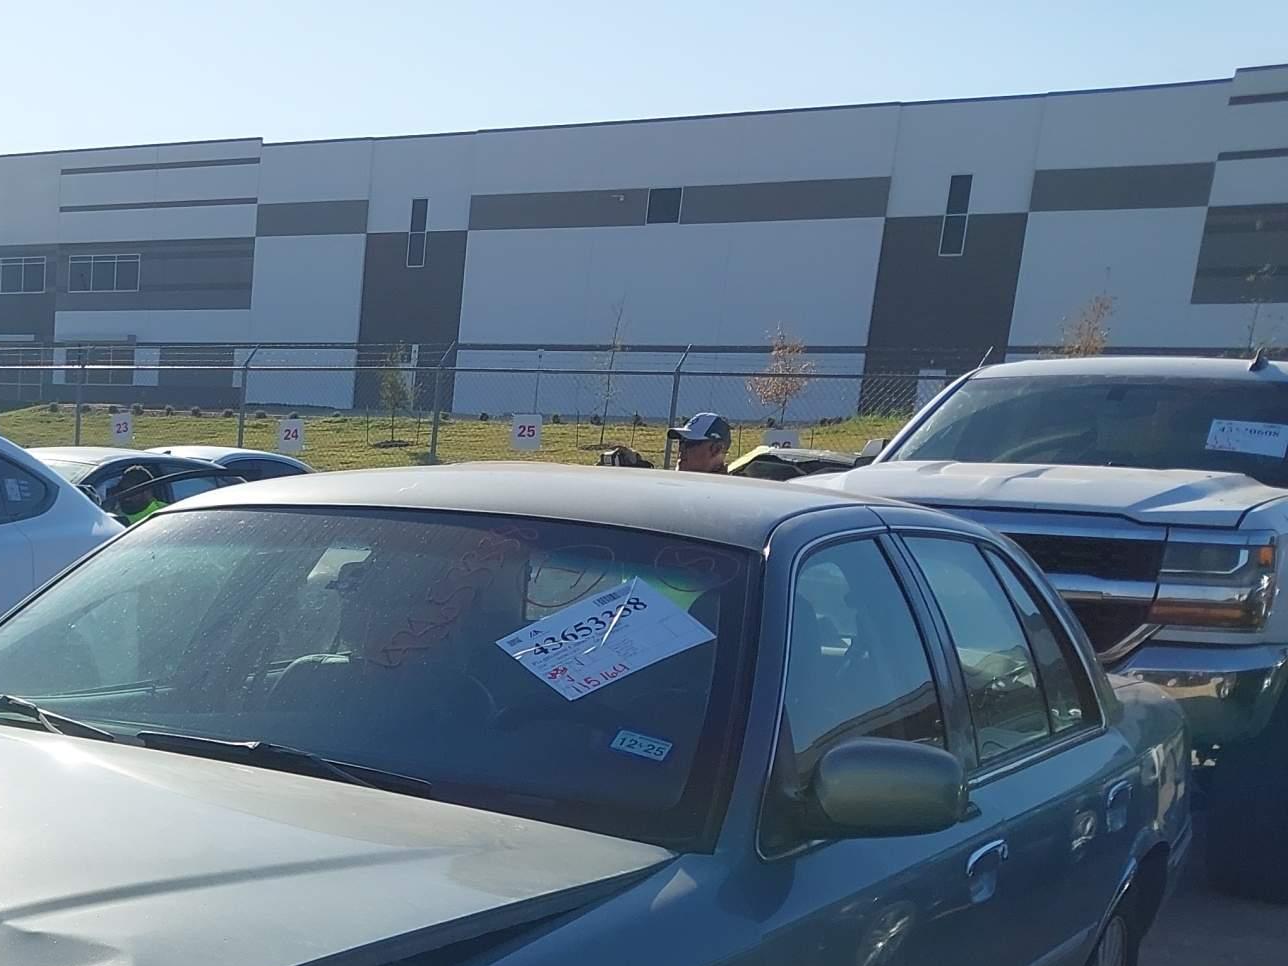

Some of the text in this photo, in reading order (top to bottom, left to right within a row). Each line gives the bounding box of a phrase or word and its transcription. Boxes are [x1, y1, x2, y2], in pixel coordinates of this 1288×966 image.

[116, 422, 129, 434] 23
[283, 428, 299, 441] 24
[517, 425, 536, 438] 25
